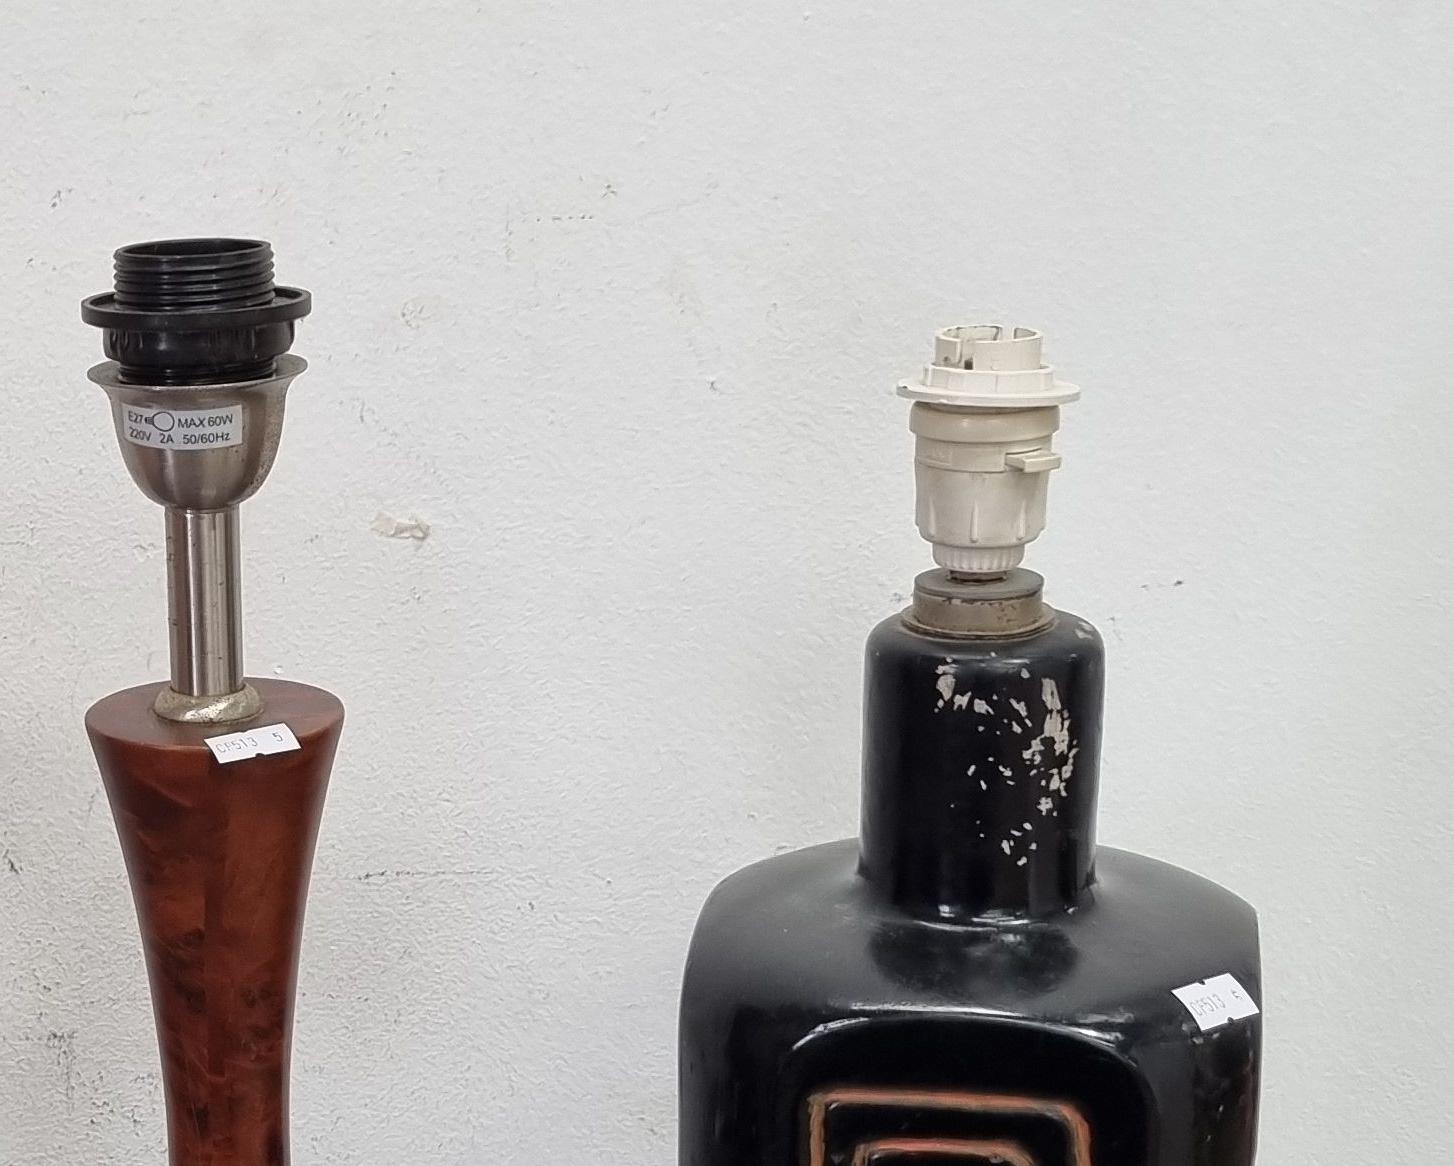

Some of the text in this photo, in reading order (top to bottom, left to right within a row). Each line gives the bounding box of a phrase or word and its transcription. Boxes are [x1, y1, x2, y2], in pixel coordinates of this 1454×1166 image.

[128, 411, 233, 428] E27 MAX 60W
[129, 427, 231, 444] 220V 2A 50/60Hz
[272, 731, 283, 742] 5
